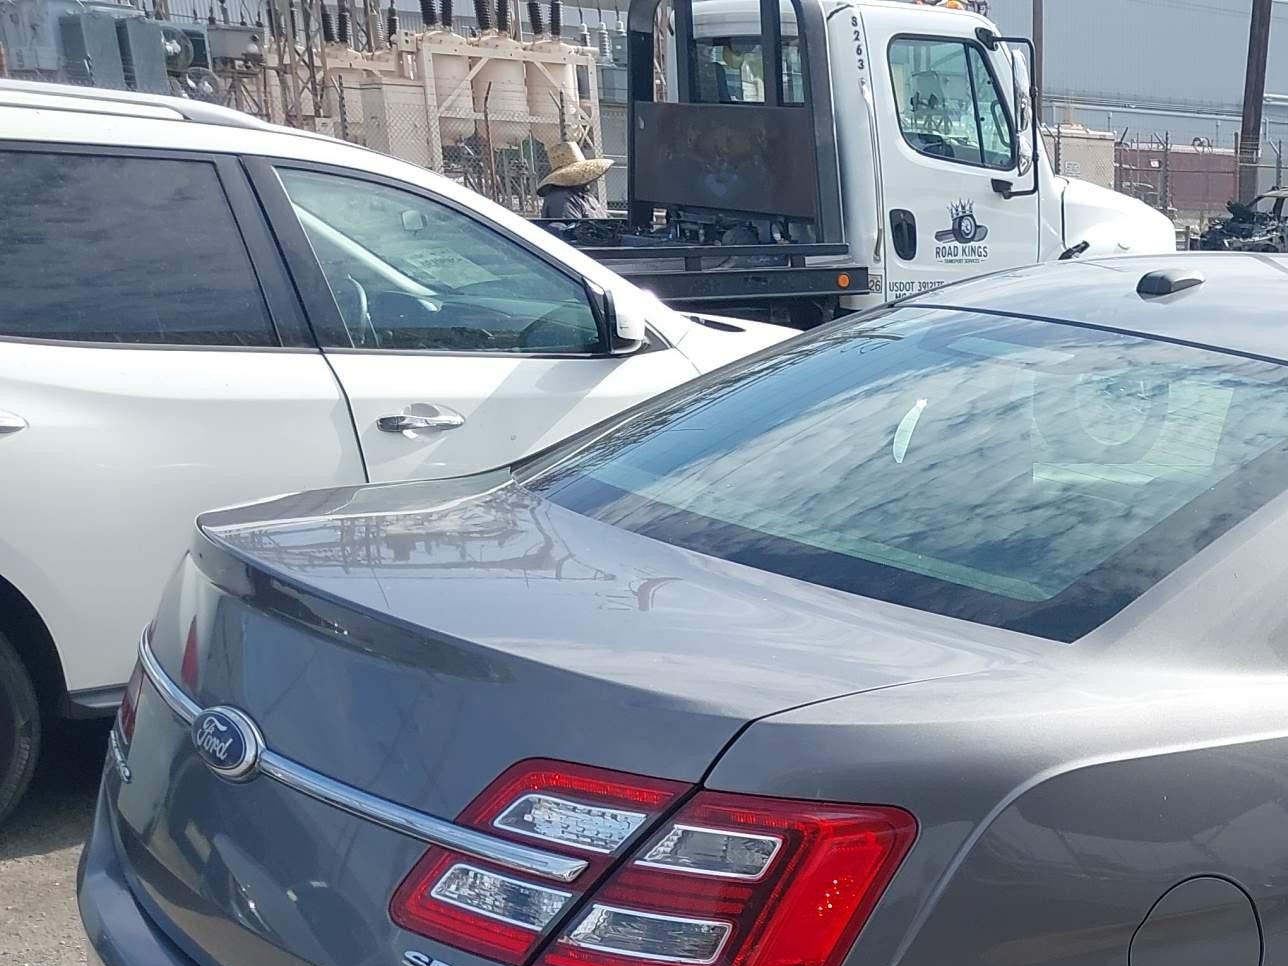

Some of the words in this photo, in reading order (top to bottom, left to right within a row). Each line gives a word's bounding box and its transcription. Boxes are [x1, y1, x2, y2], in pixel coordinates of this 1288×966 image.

[935, 245, 958, 258] ROAD
[961, 244, 988, 258] KINGS
[888, 281, 915, 292] USDOT
[196, 716, 233, 760] Ford
